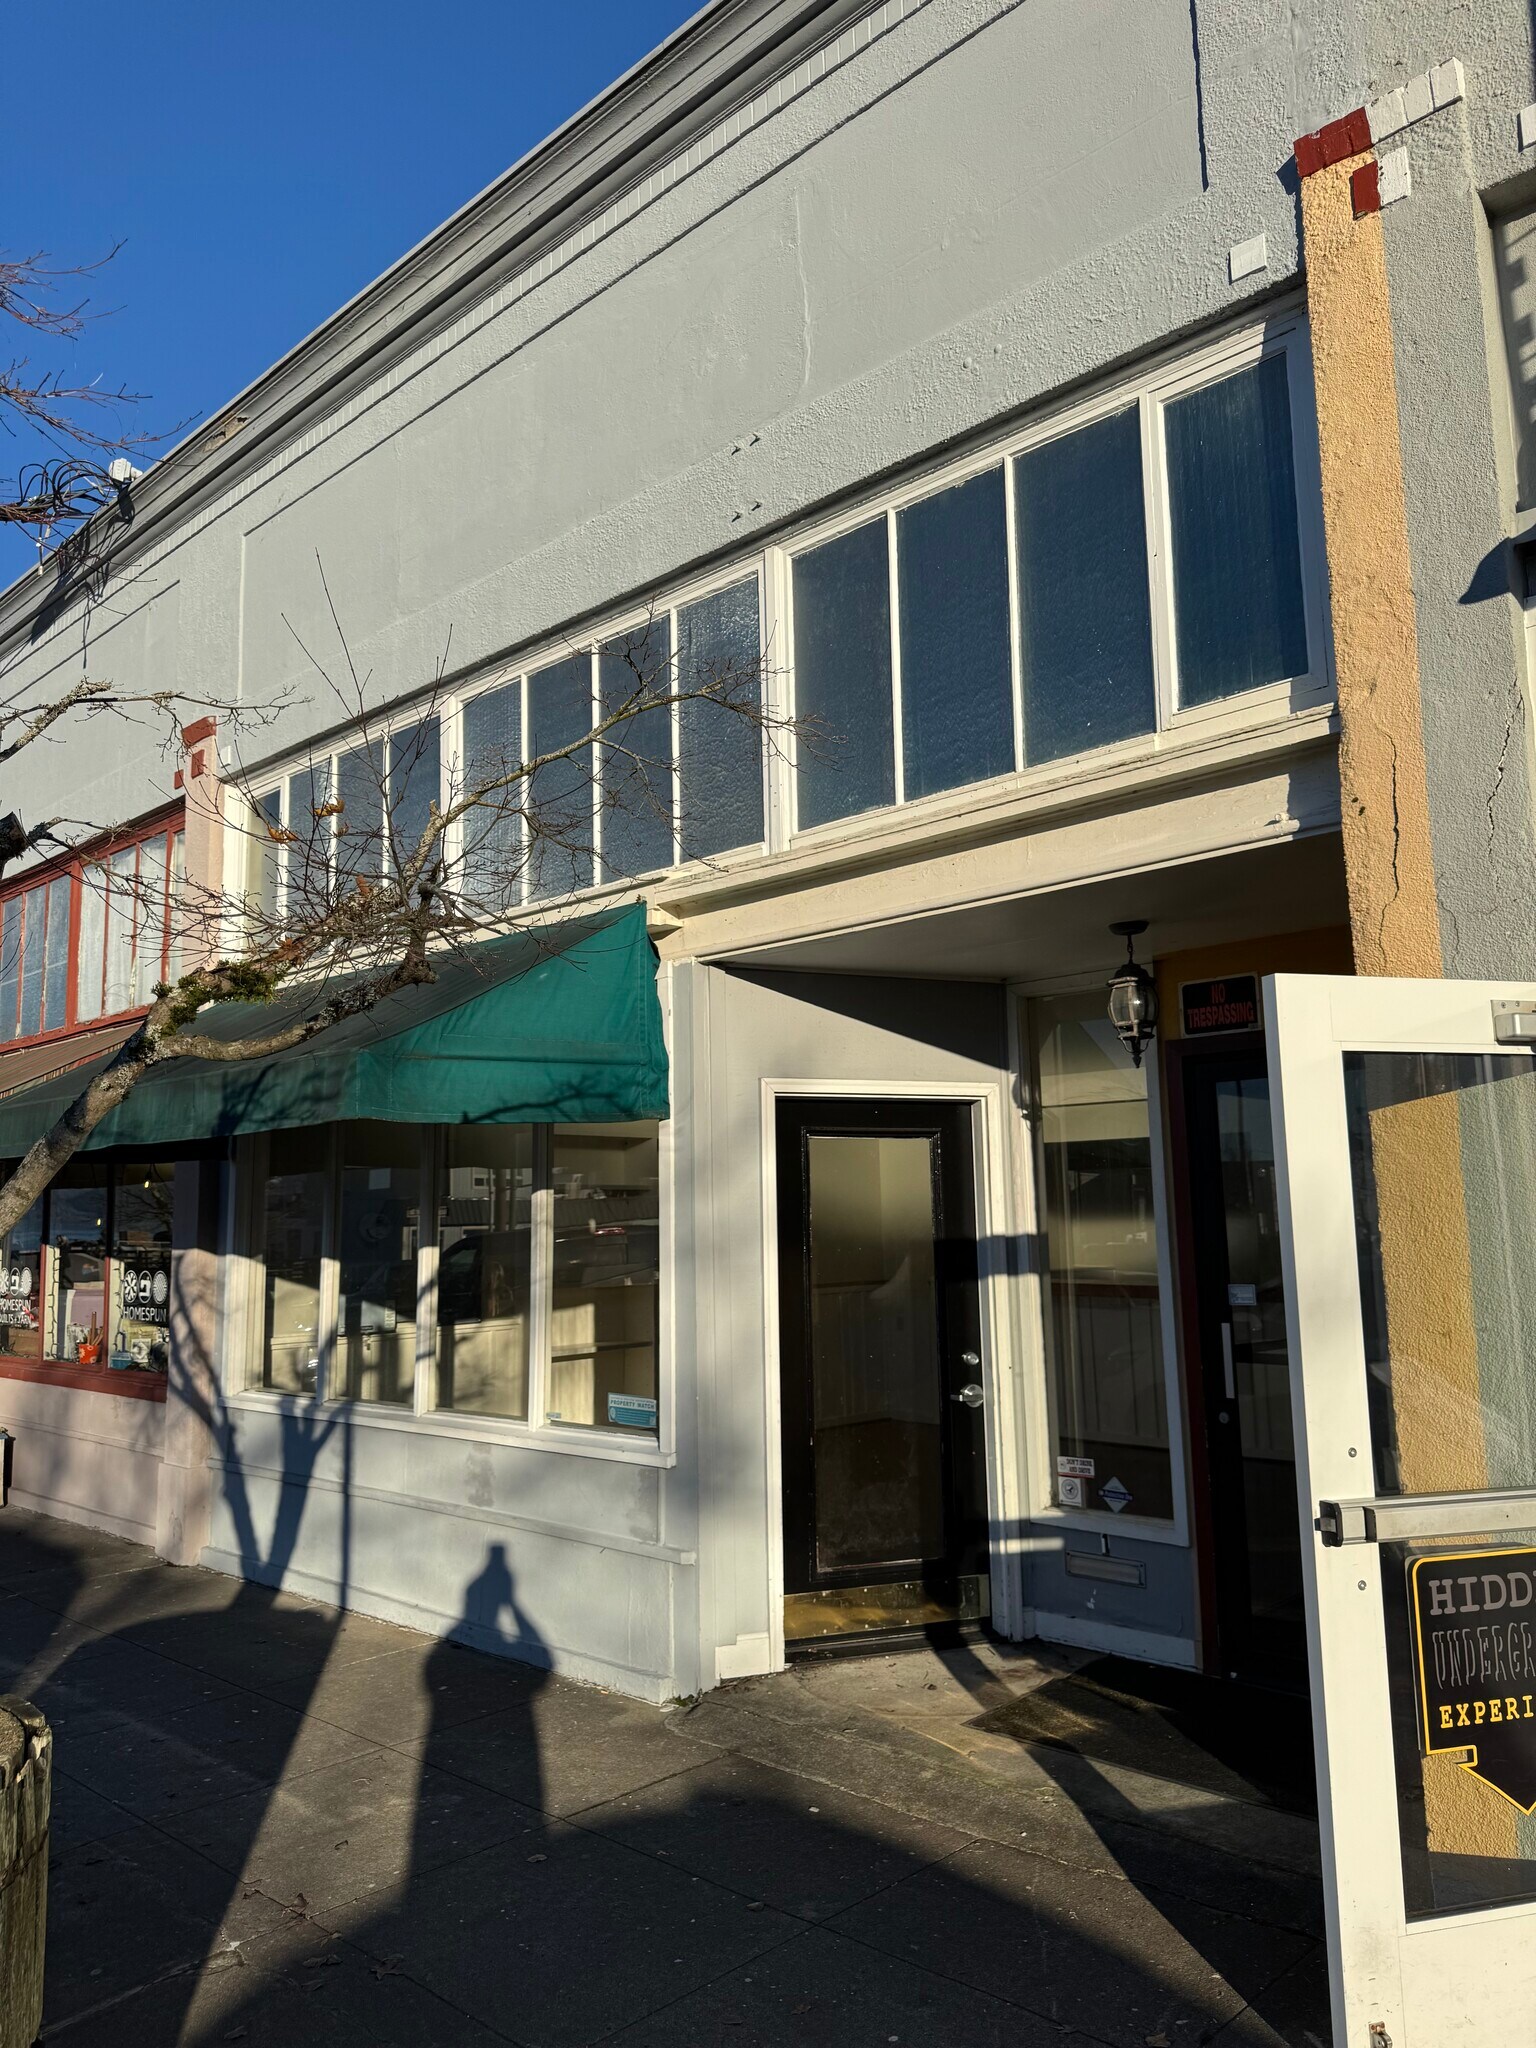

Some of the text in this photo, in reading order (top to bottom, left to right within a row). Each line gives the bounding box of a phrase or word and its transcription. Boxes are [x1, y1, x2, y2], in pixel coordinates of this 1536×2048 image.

[1211, 983, 1225, 1003] NO
[1187, 1001, 1254, 1029] TRESPASSING
[123, 1306, 167, 1322] HOMESPUN
[610, 1399, 635, 1408] PROPERTY
[1428, 1570, 1536, 1616] HIDD
[1439, 1695, 1535, 1729] EXPERI
